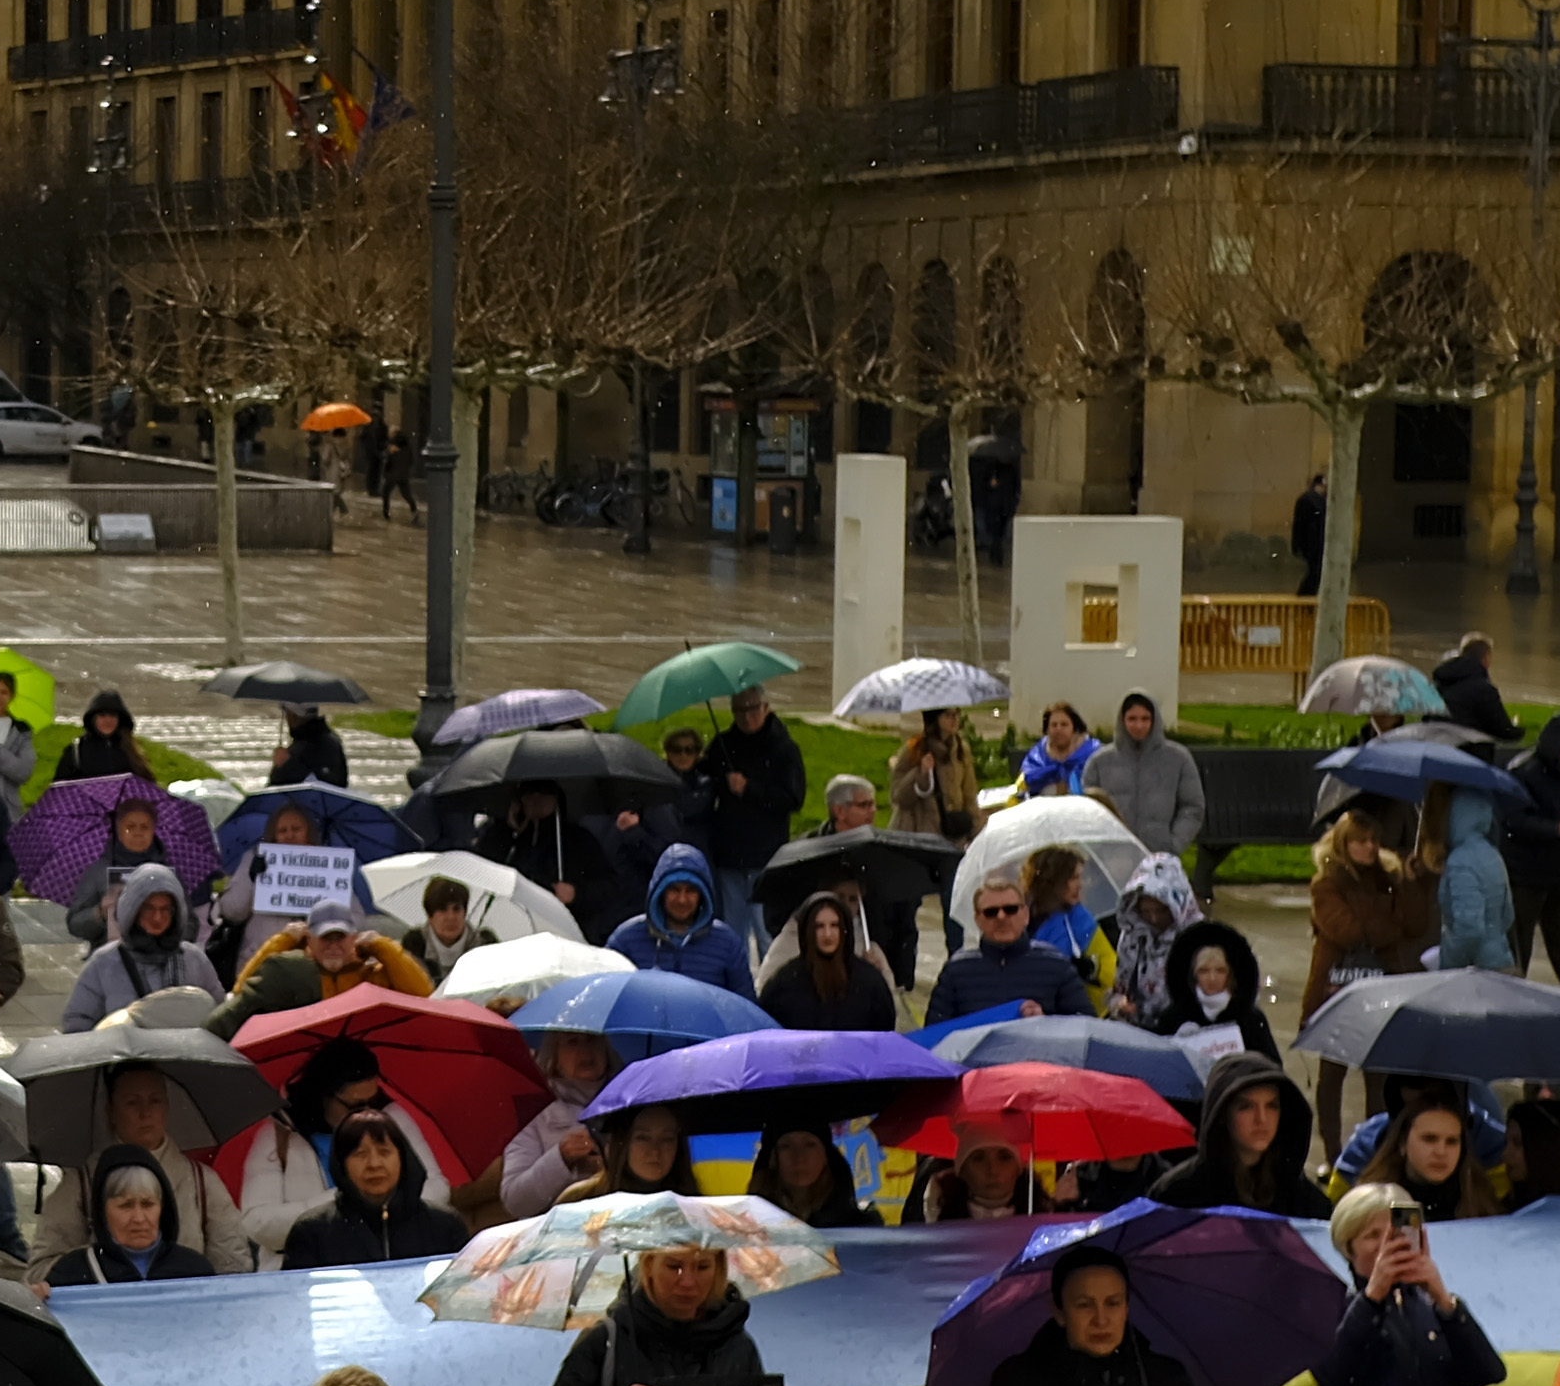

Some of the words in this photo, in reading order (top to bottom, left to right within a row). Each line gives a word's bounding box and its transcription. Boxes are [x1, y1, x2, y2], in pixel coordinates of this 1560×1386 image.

[333, 856, 350, 870] no
[335, 878, 348, 890] es
[271, 893, 282, 907] el
[287, 893, 328, 908] Mund
